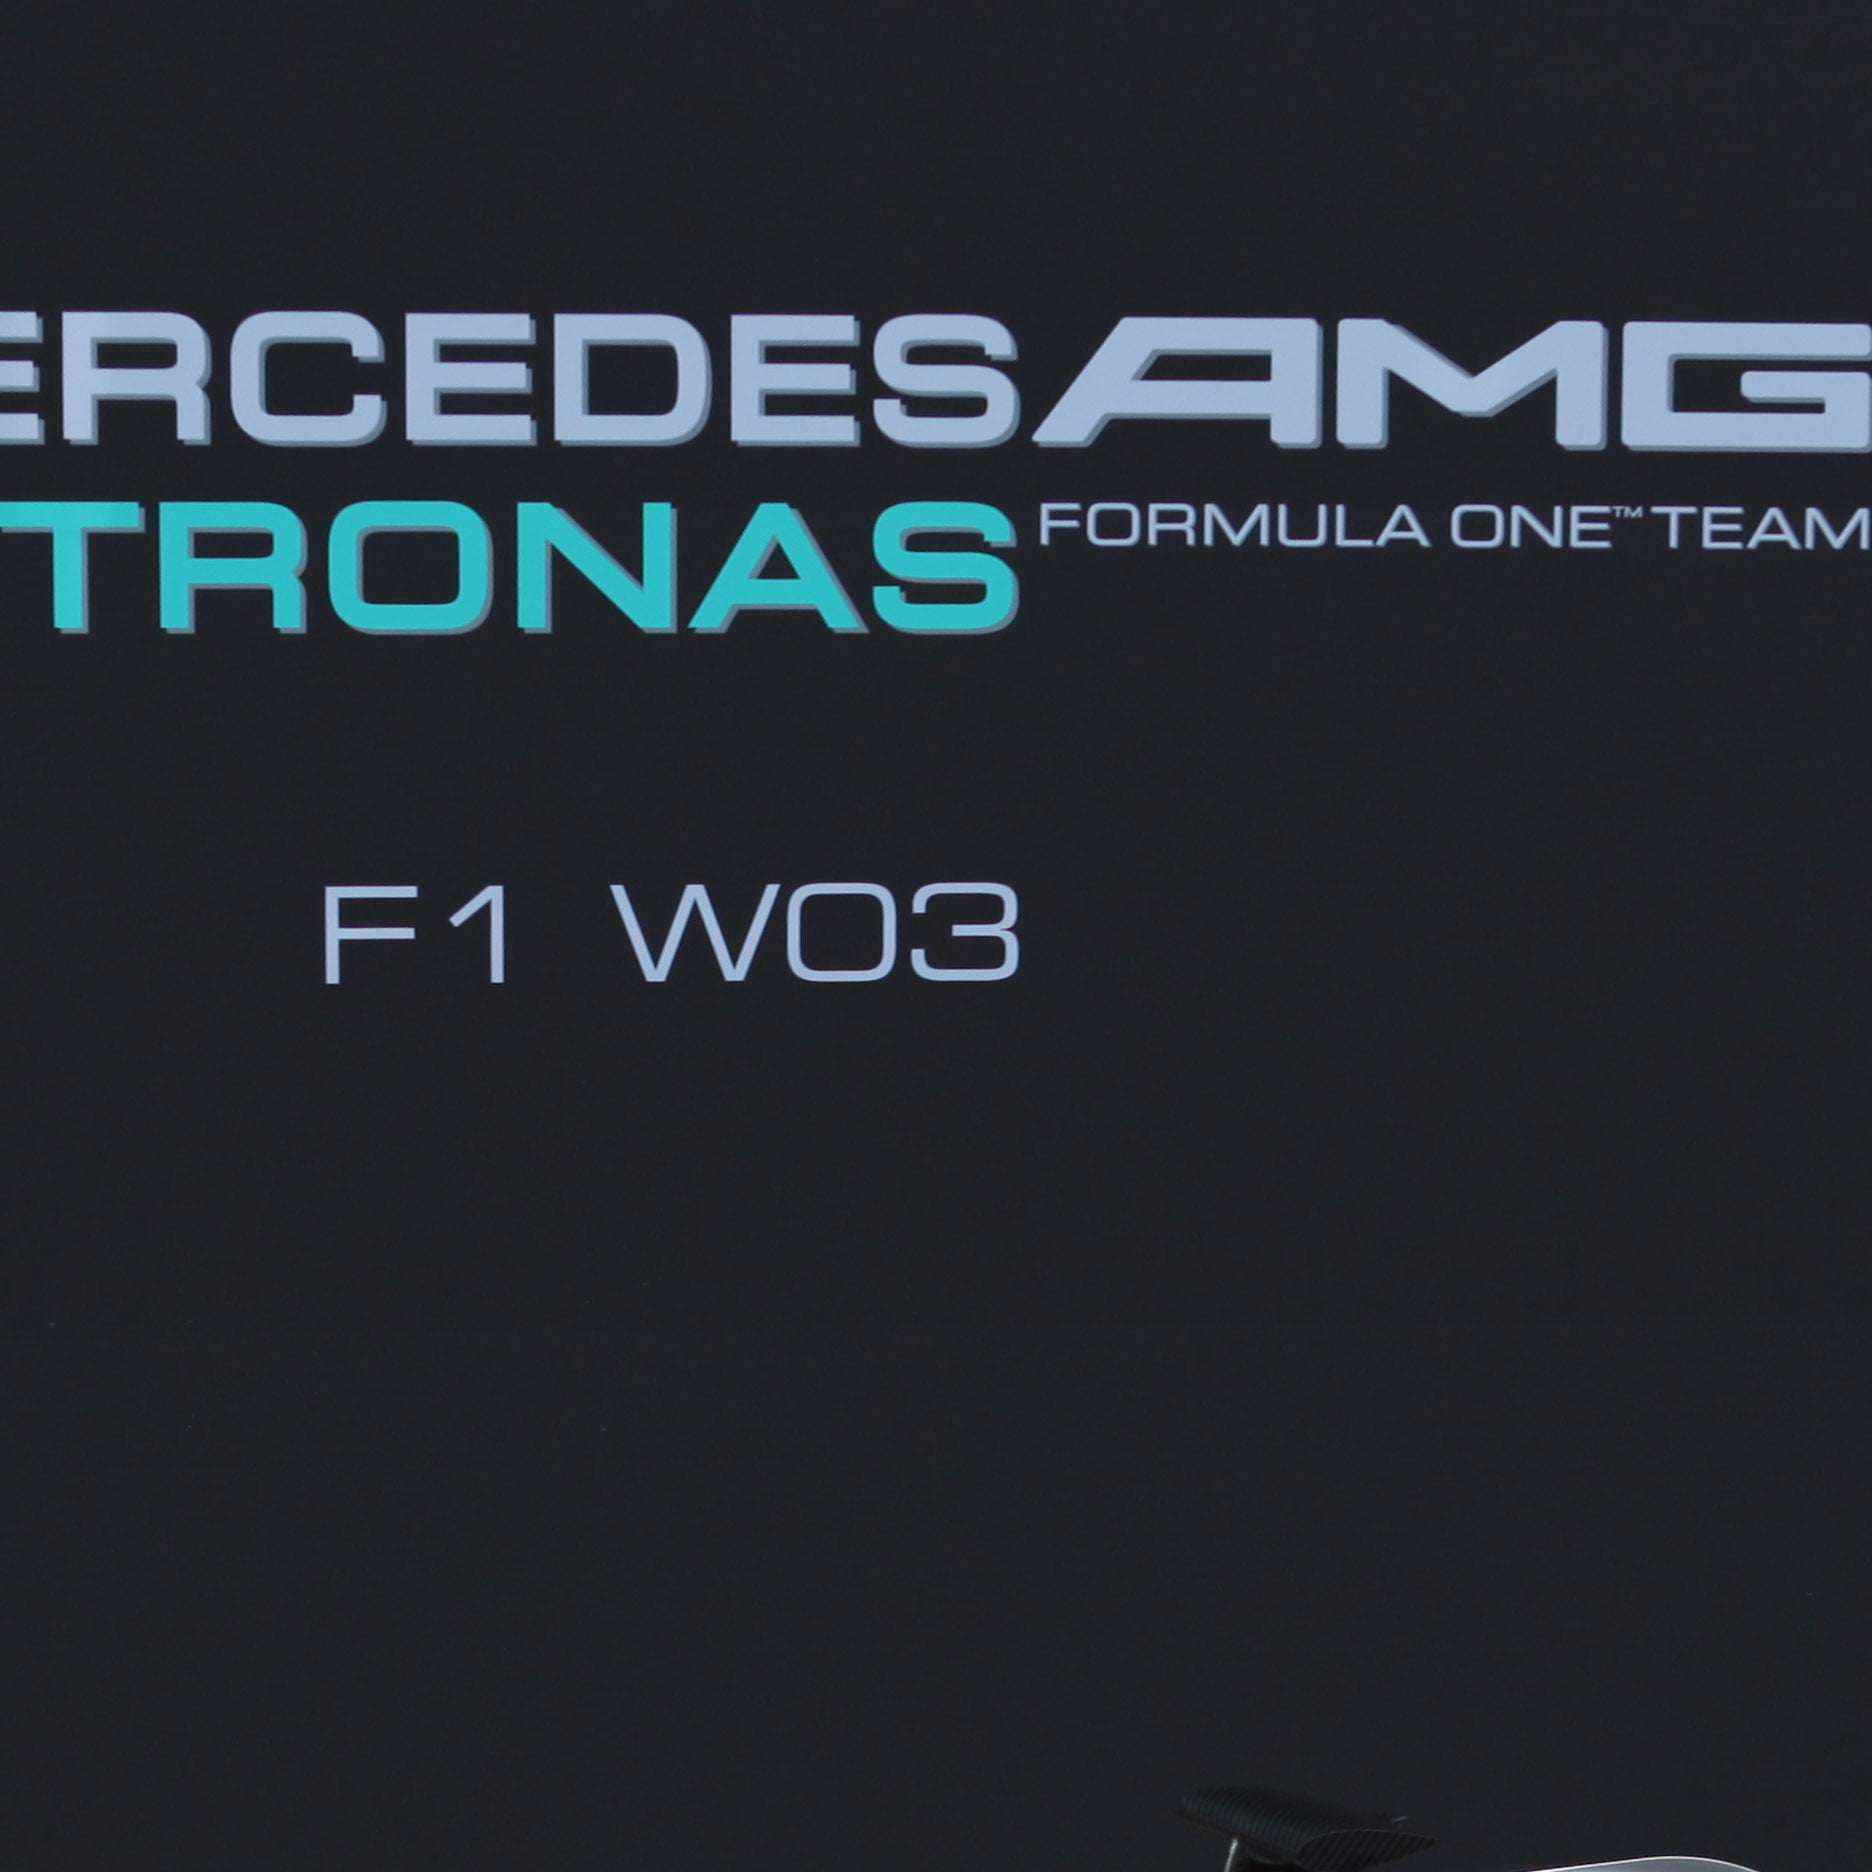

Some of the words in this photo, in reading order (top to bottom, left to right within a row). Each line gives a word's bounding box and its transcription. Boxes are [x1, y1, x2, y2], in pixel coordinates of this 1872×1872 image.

[1040, 502, 1431, 547] FORMULA
[1651, 506, 1871, 550] TEAM
[325, 885, 504, 984] F1
[610, 882, 1020, 982] W03
